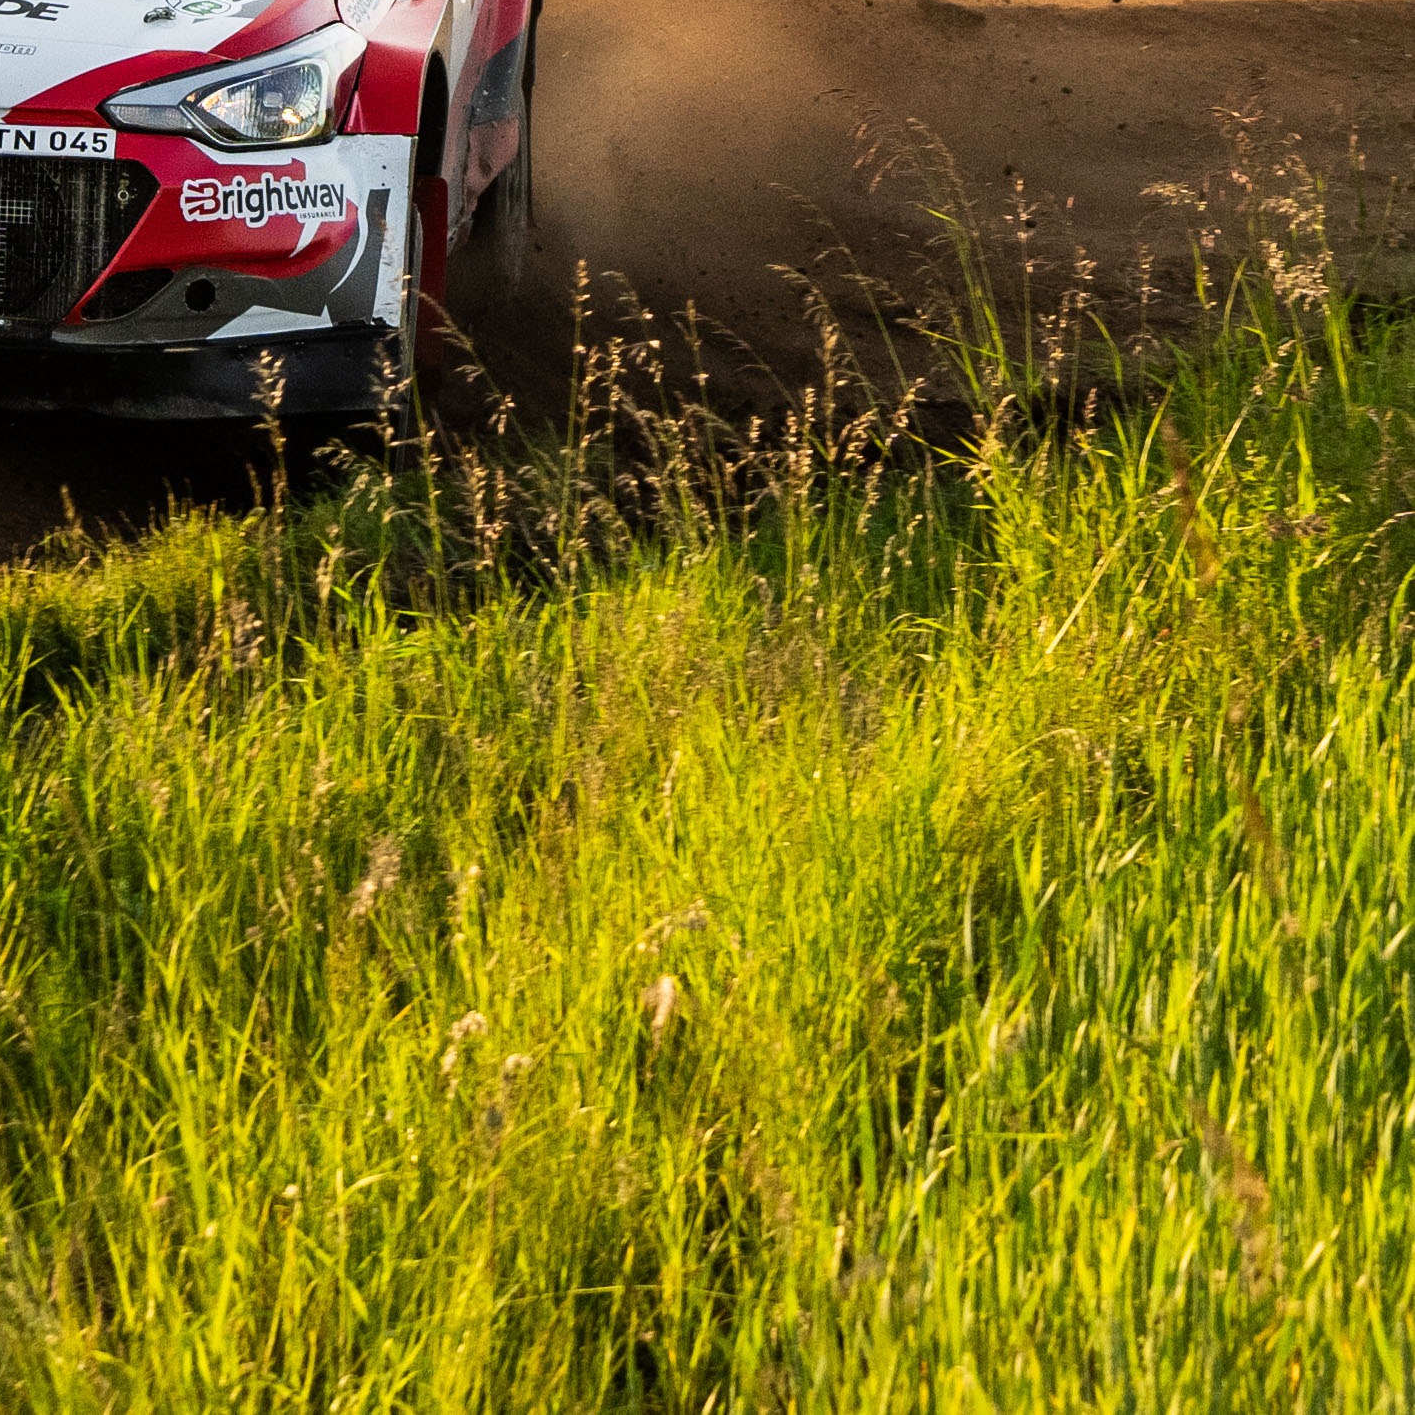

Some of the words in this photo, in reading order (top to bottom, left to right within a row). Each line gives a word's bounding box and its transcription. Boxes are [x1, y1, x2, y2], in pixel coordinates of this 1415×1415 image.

[49, 131, 108, 153] 045
[185, 178, 345, 223] Brightway
[299, 211, 337, 219] INSURANCE
